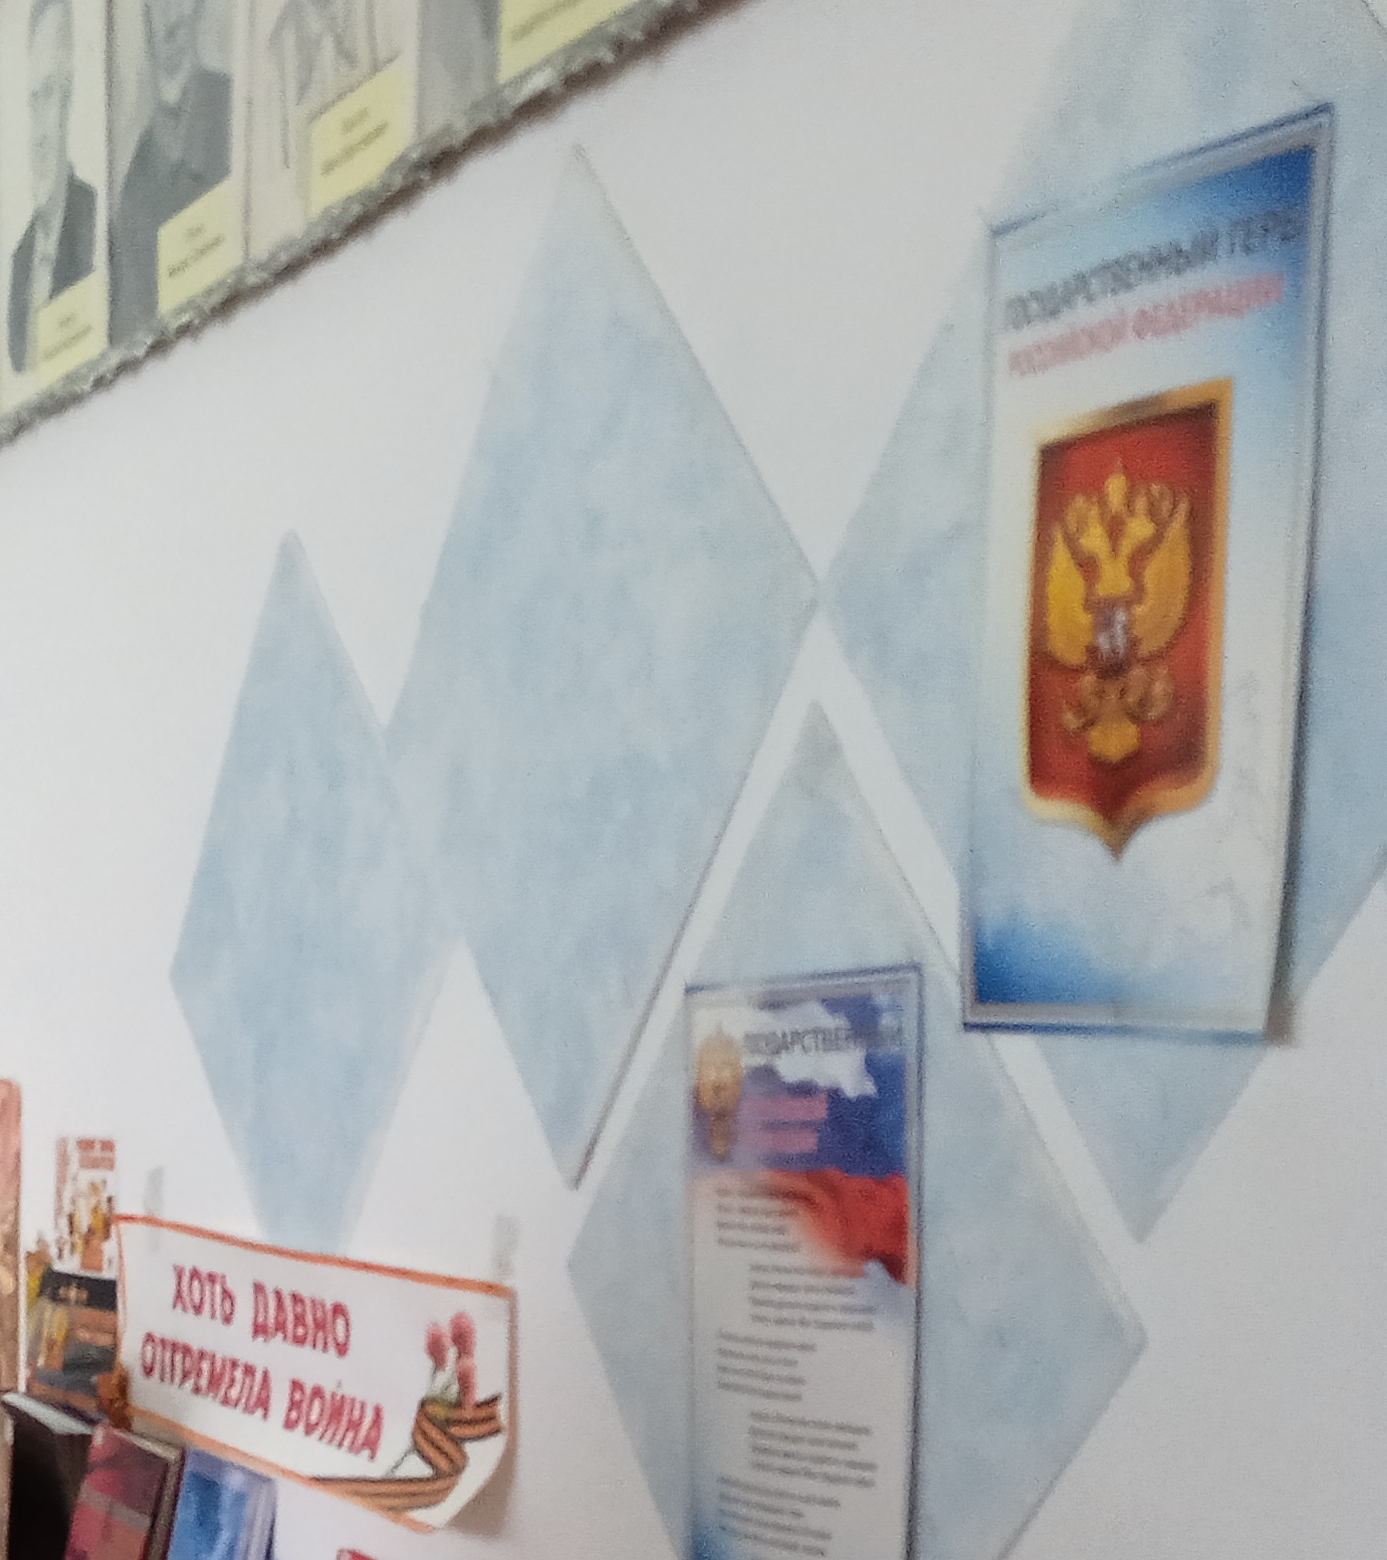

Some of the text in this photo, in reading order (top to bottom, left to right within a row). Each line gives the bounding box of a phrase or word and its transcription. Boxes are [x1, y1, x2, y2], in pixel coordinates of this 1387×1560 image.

[172, 1263, 352, 1358] ХОТЬ ДАВНО
[140, 1331, 384, 1461] ОТГРЕМЕЛА ВОЙНА
